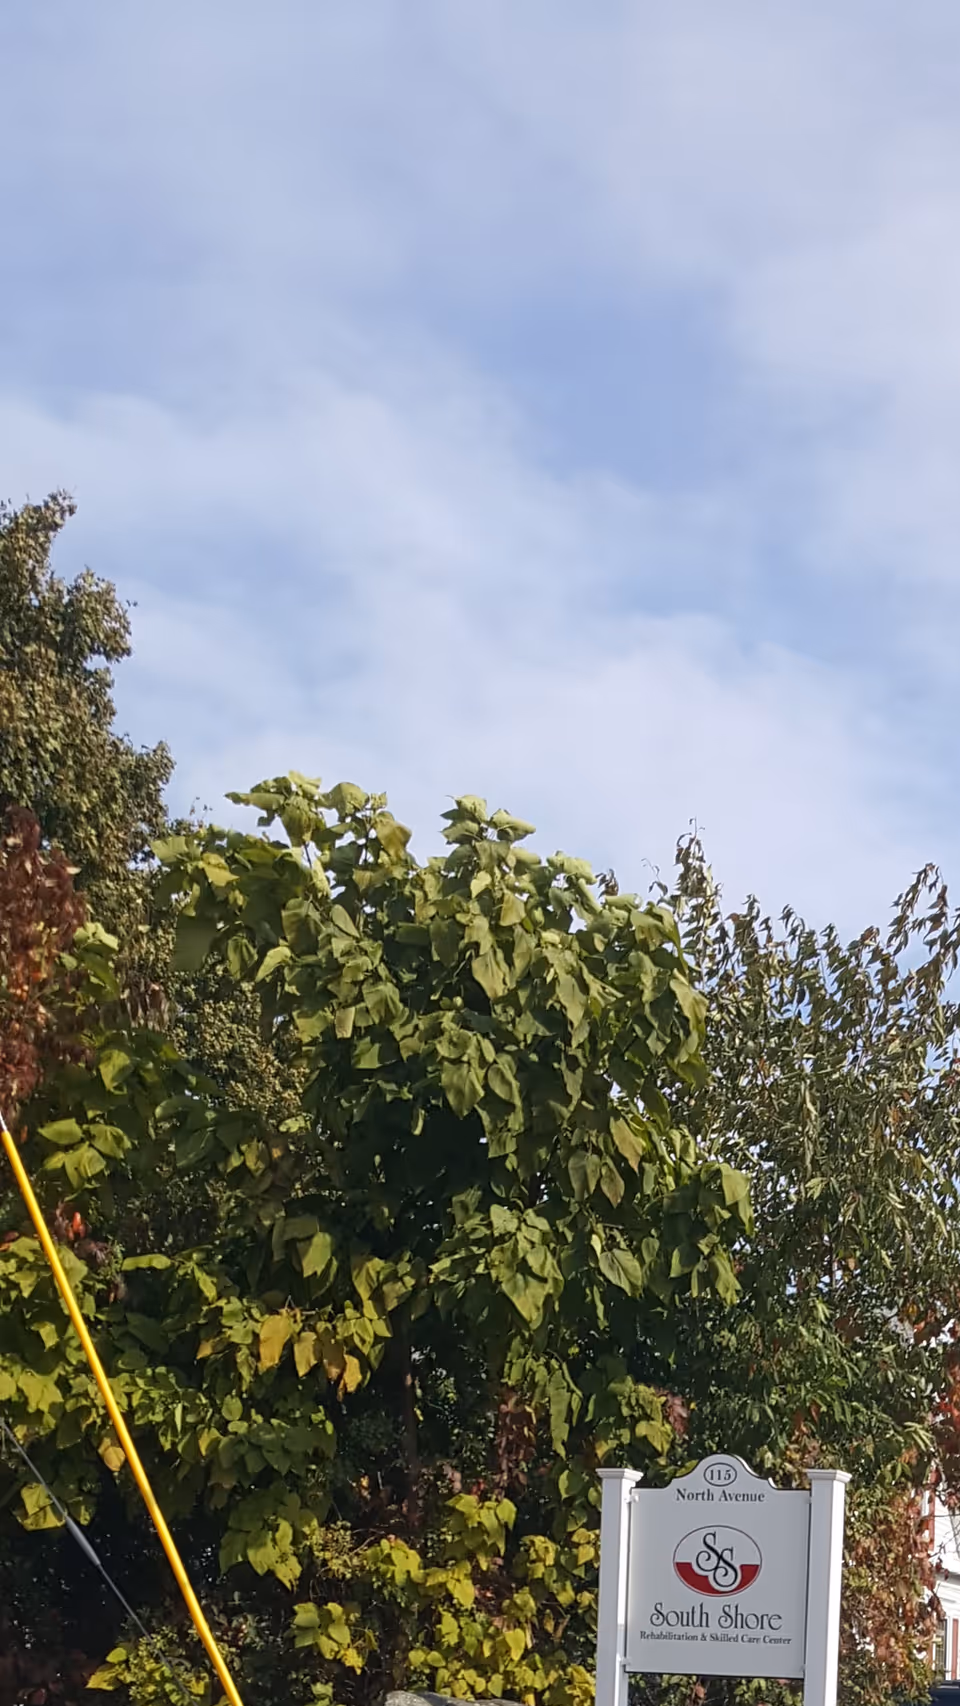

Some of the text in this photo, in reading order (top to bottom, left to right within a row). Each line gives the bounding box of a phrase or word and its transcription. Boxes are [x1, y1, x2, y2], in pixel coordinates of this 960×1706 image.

[708, 1469, 732, 1481] 115
[676, 1488, 765, 1503] North Avenue
[649, 1602, 783, 1630] South Shore
[639, 1631, 792, 1645] Rehabilitation & Skilled Care Center
